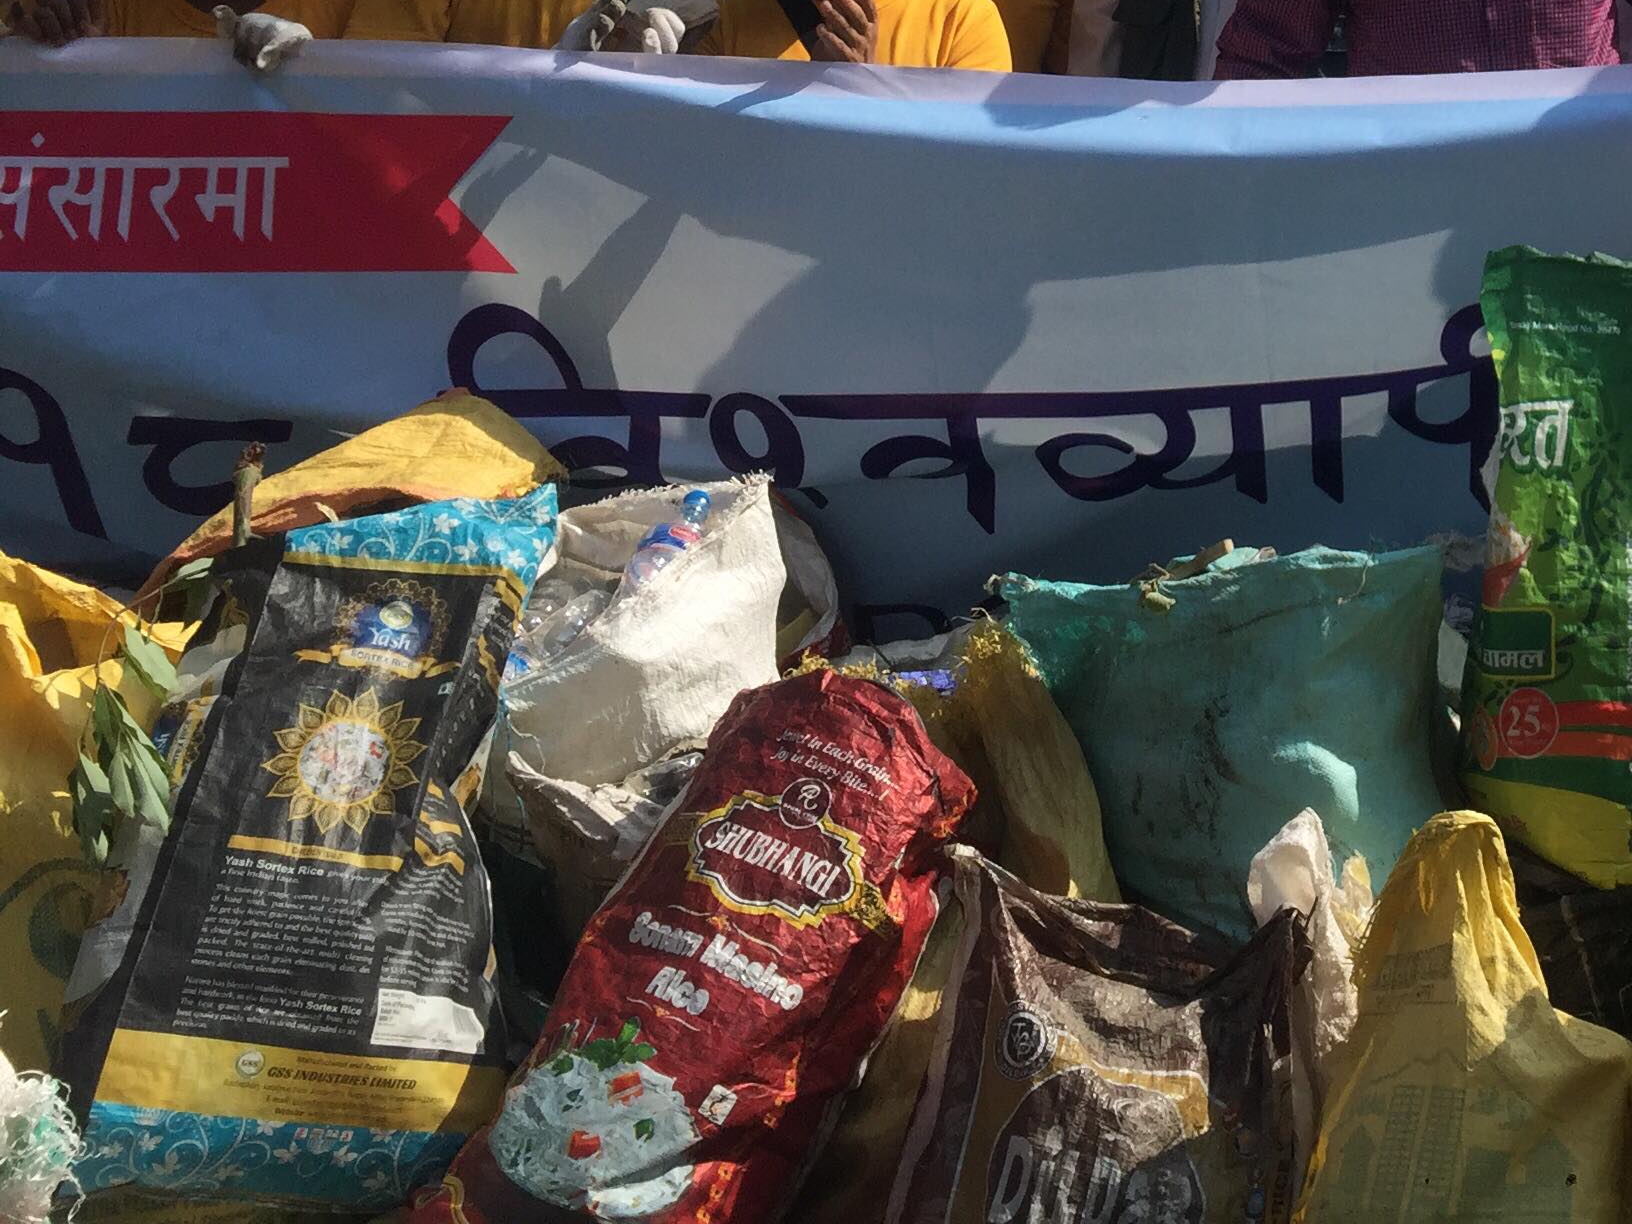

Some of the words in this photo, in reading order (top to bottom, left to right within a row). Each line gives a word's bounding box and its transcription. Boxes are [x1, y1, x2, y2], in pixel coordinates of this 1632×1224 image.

[368, 627, 411, 650] Yash
[1507, 705, 1540, 736] 25
[822, 742, 855, 764] Each
[805, 755, 841, 780] Every
[225, 856, 254, 868] Yash
[256, 859, 295, 874] Sortex
[298, 866, 324, 877] Rice
[704, 821, 841, 897] SHUBHANGI
[279, 997, 303, 1009] Yash
[305, 1000, 338, 1013] Sortex
[340, 1005, 362, 1016] Rice
[267, 1066, 293, 1078] GSS
[294, 1069, 369, 1086] INDUSTRIES
[370, 1076, 417, 1090] LIMITED
